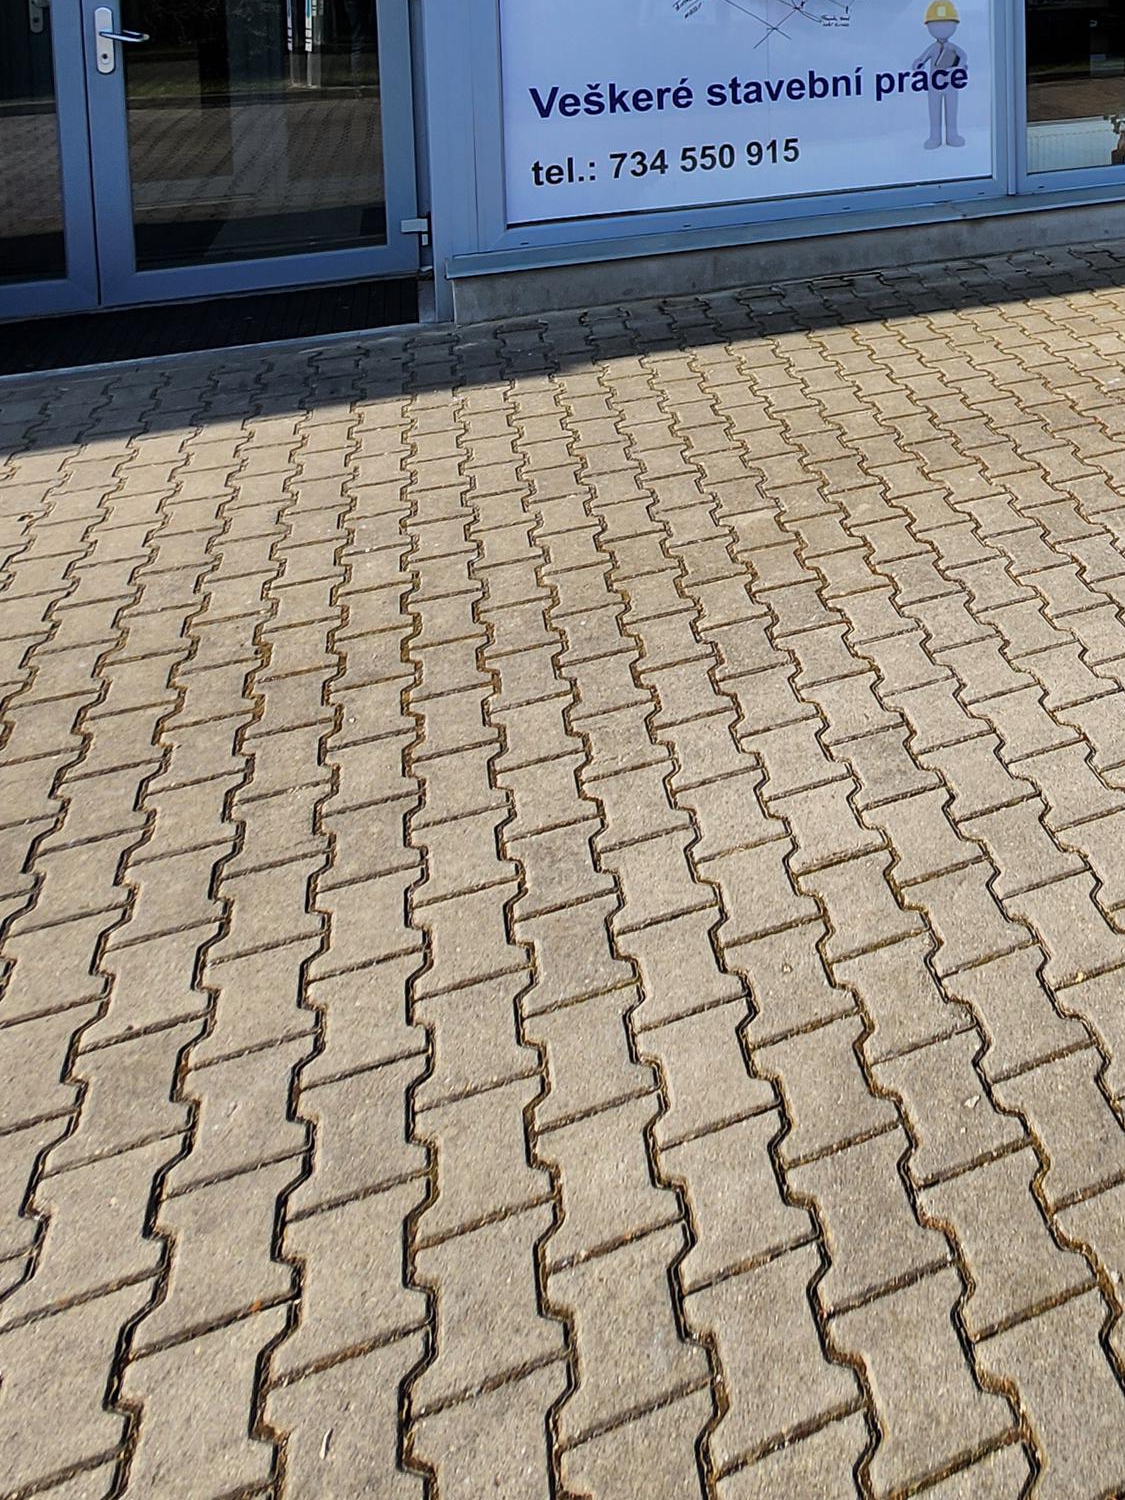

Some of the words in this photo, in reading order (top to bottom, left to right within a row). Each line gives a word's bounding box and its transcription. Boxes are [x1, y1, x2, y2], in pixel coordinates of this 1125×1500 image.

[530, 77, 694, 119] Veškeré
[706, 66, 863, 107] stavební
[875, 66, 969, 102] práce
[532, 156, 597, 186] tel.:
[610, 149, 669, 179] 734
[680, 144, 735, 173] 550
[747, 137, 800, 167] 915
